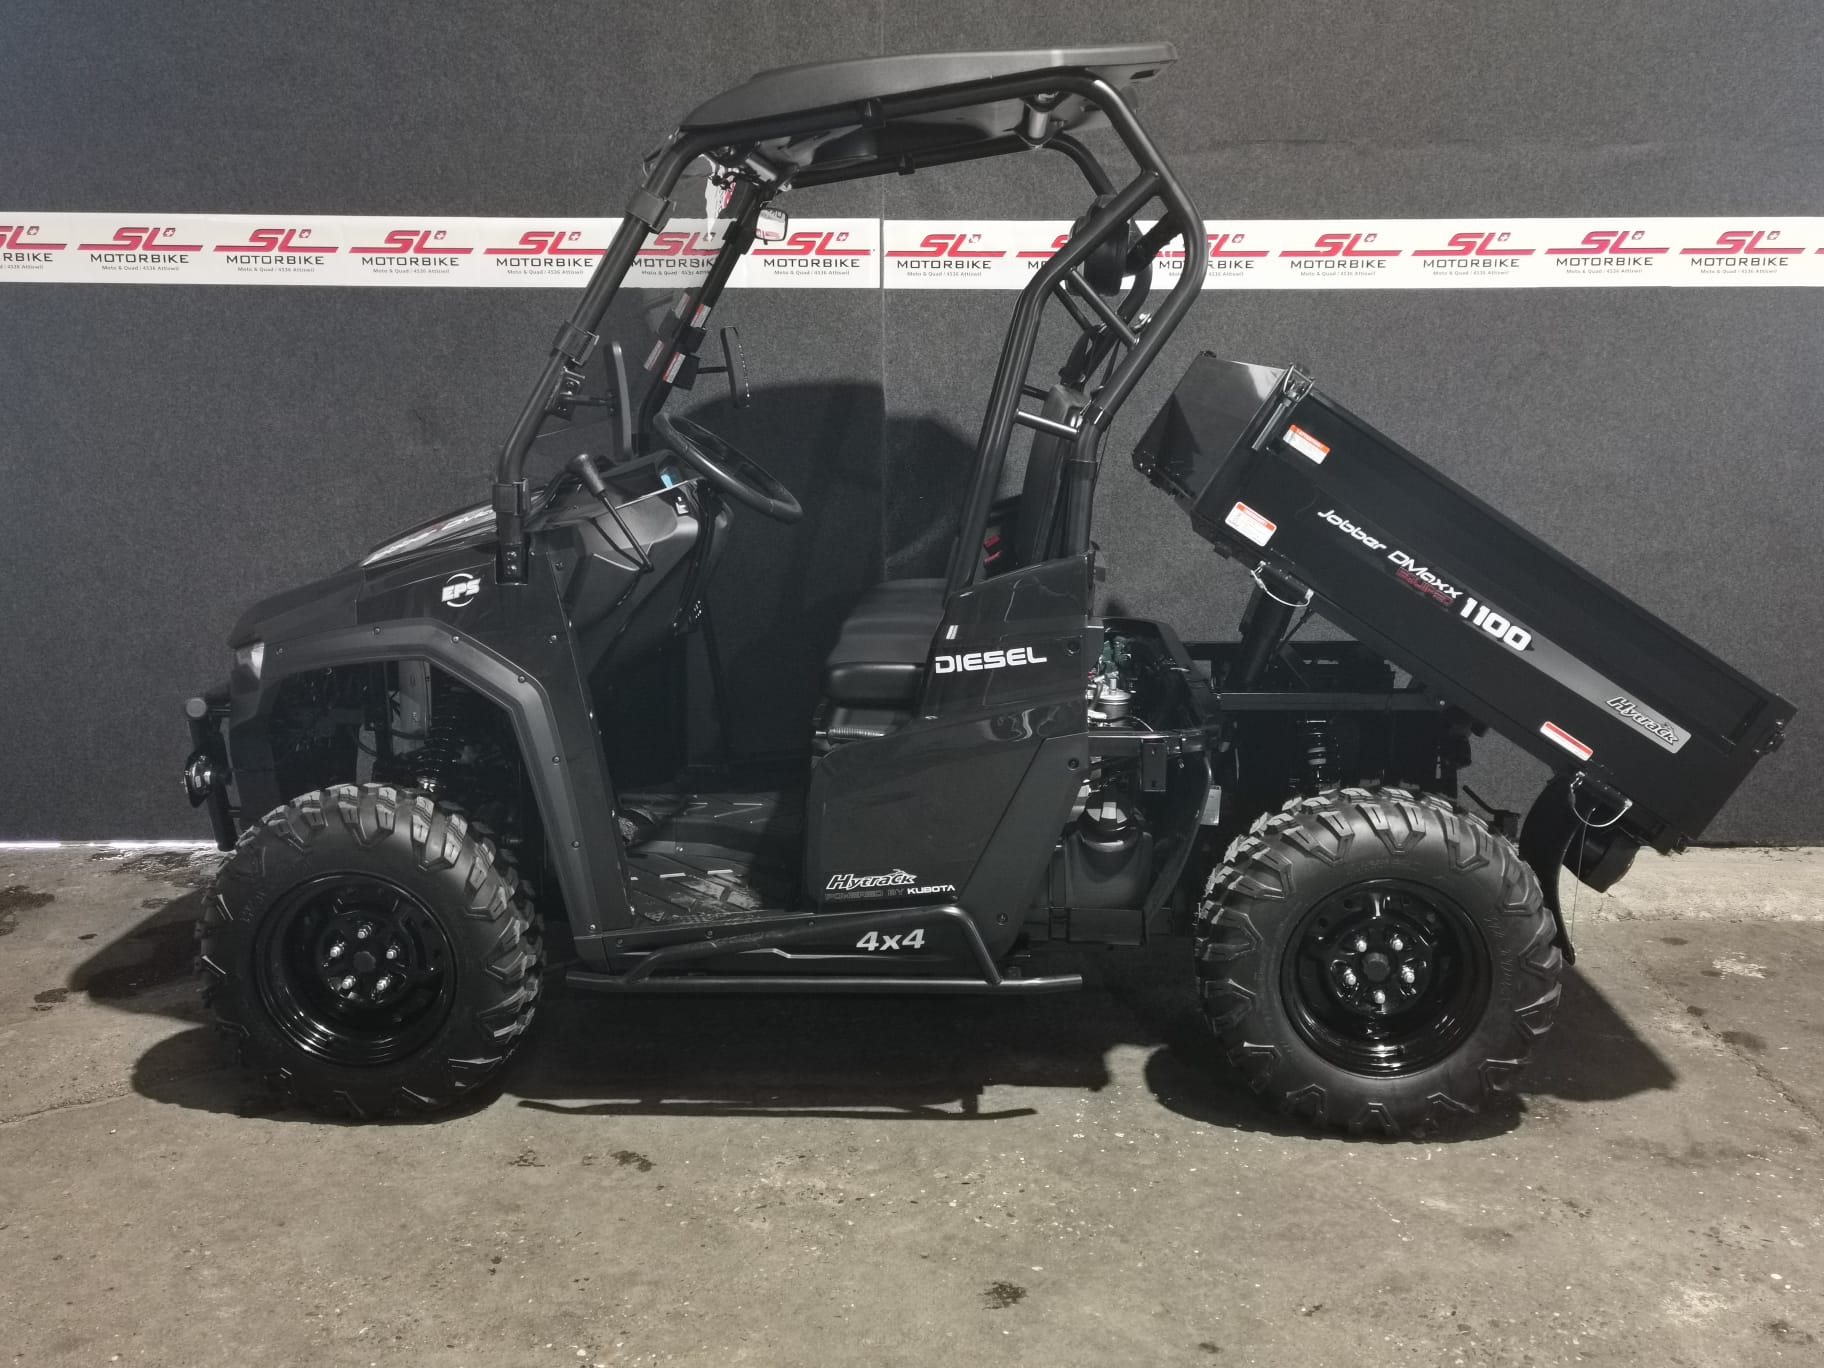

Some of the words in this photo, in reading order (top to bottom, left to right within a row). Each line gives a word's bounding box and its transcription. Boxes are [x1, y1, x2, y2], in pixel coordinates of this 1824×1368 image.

[3, 253, 53, 262] RBIKE
[91, 254, 189, 263] MOTORBIKE
[227, 255, 324, 264] MOTORBIKE
[362, 257, 459, 266] MOTORBIKE
[1557, 257, 1653, 266] MOTORBIKE
[1691, 257, 1789, 266] MOTORBIKE
[497, 258, 593, 267] MOTORBIKE
[632, 259, 714, 268] MOTORBIK
[764, 259, 860, 267] MOTORBIKE
[897, 260, 992, 269] MOTORBIKE
[1159, 260, 1255, 269] MORBIKE
[1291, 260, 1386, 268] MOTORBIKE
[1423, 259, 1520, 268] MOTORBIKE
[1317, 509, 1387, 550] Jobber
[1387, 550, 1463, 599] DMaxx
[1459, 597, 1533, 652] 1100
[441, 578, 481, 602] EPS
[935, 646, 1047, 674] DIESEL
[907, 884, 956, 895] KUBOTA
[856, 929, 925, 951] 4x4
